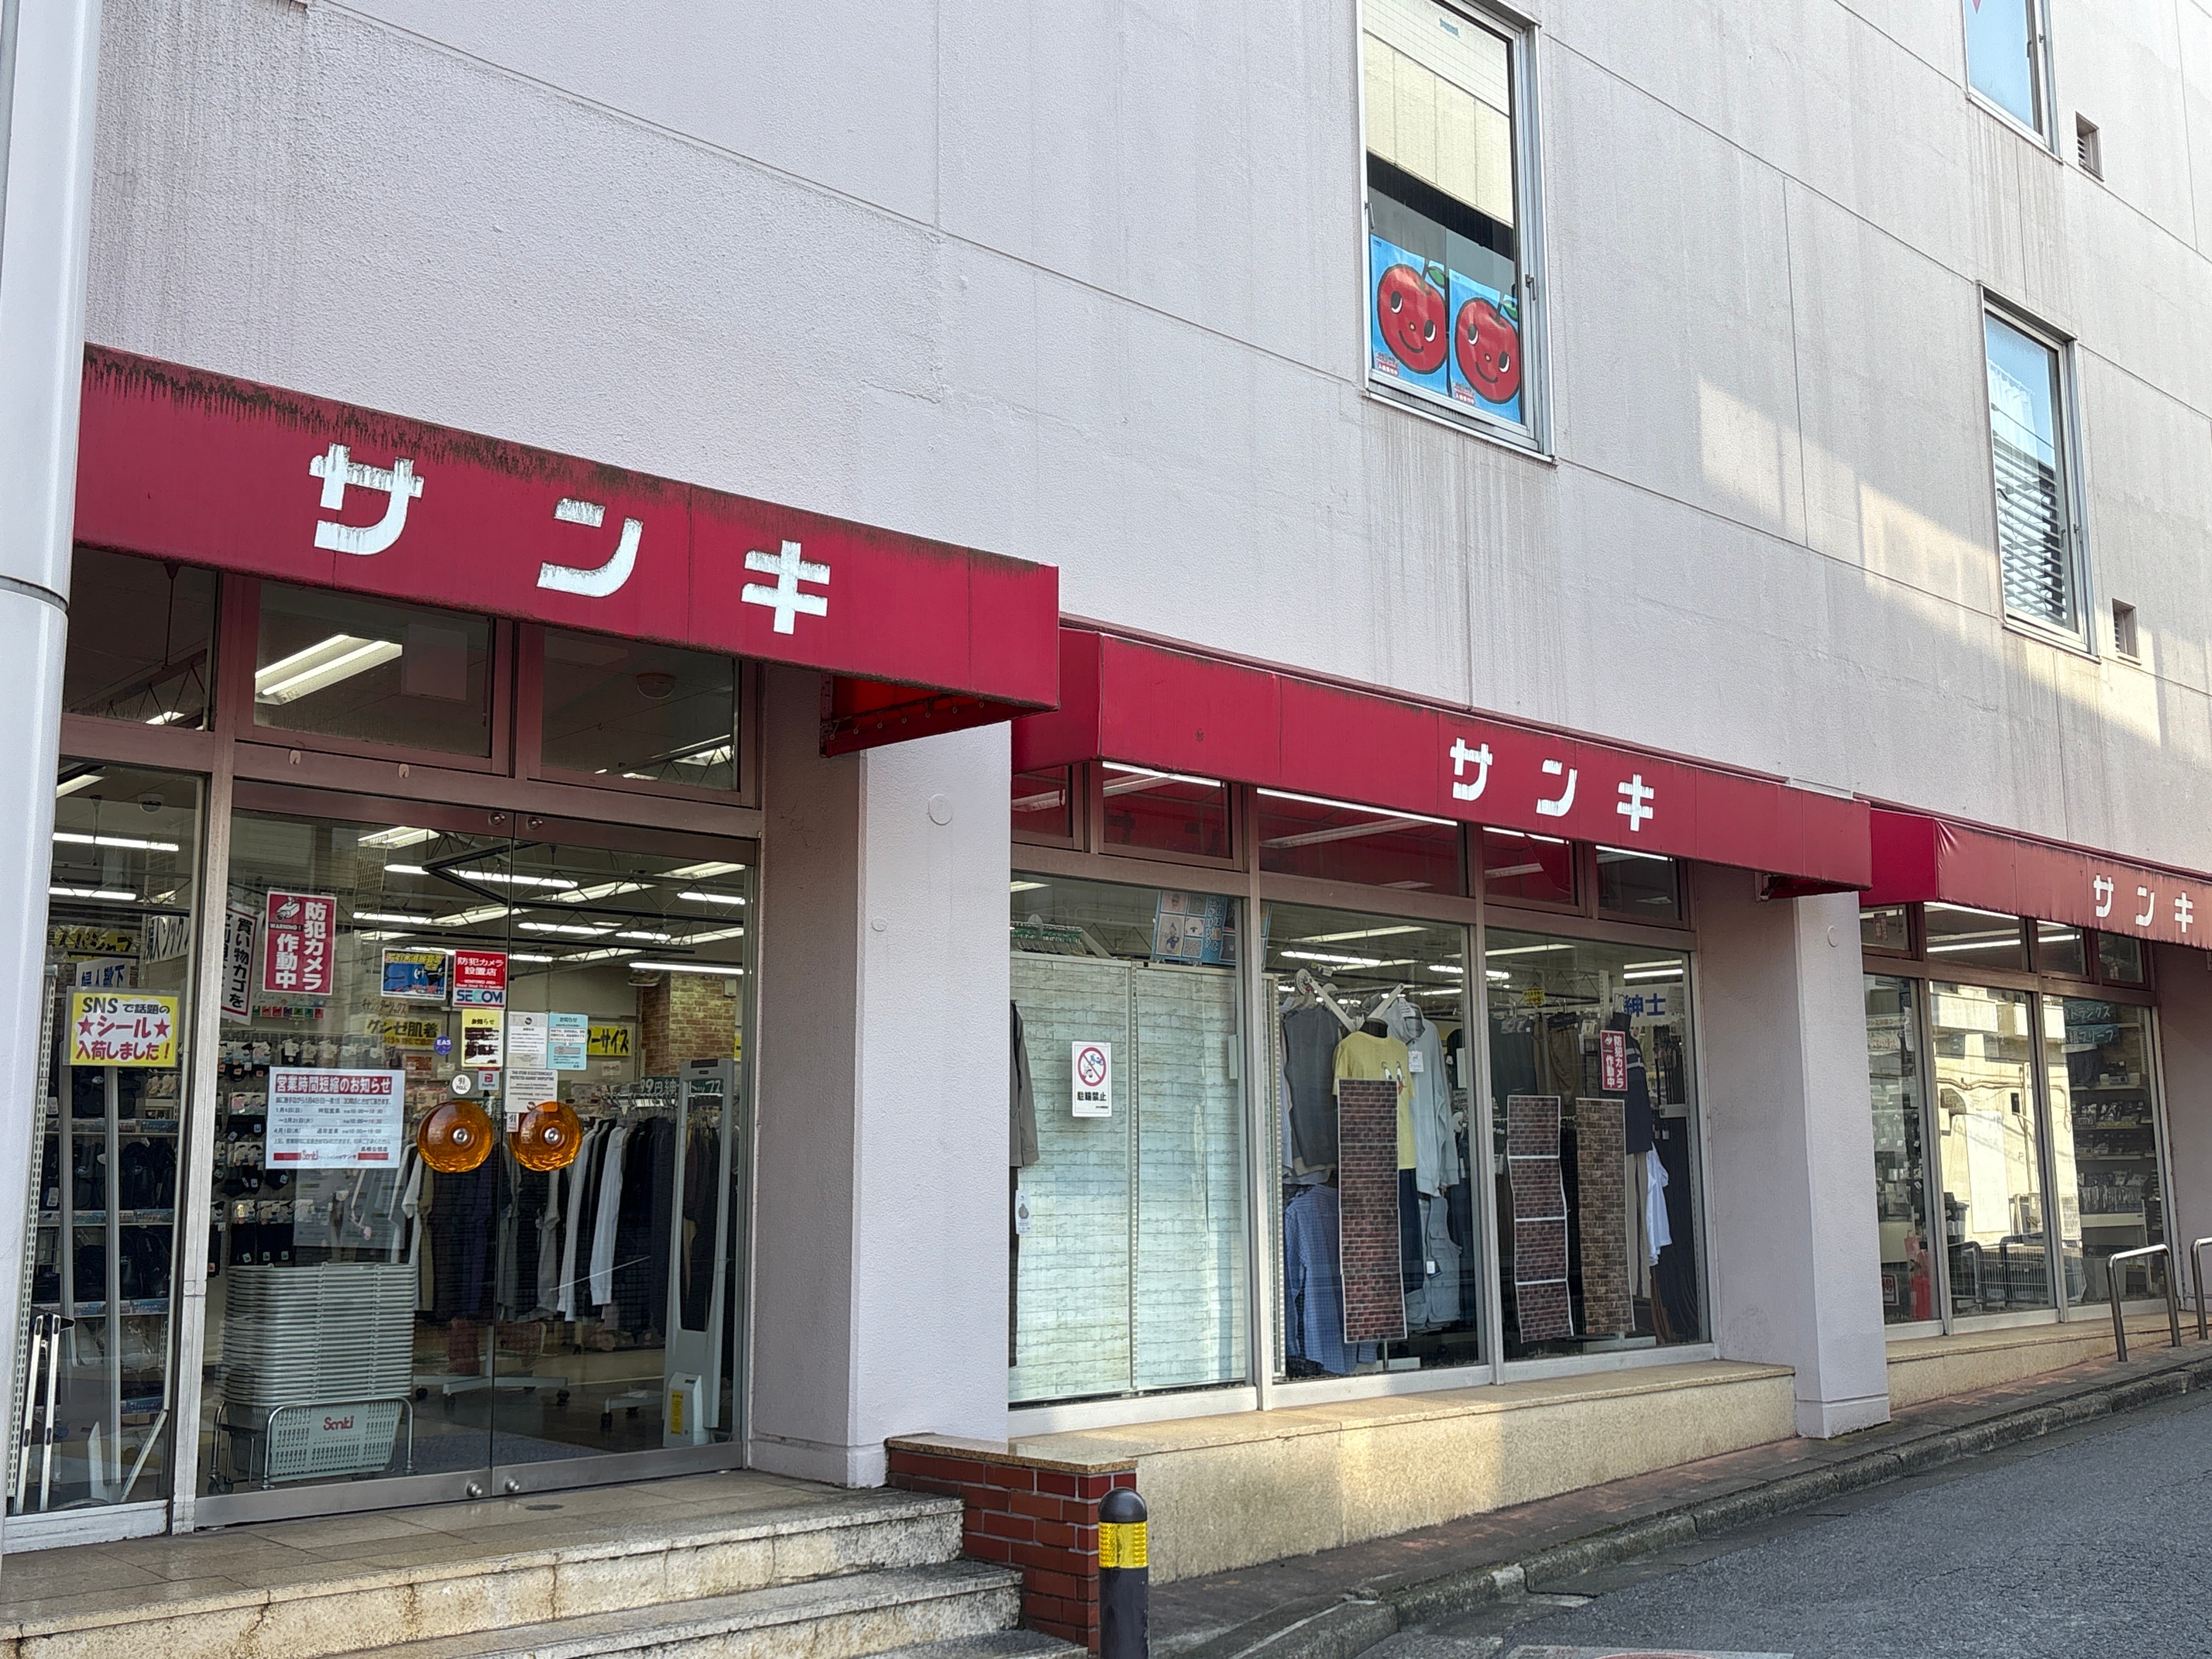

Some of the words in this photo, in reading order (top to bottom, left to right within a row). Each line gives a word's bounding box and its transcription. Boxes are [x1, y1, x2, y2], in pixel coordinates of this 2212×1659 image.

[308, 442, 832, 635] サンキ
[1450, 737, 1654, 832] サンキ
[2094, 874, 2193, 933] サンキ
[229, 917, 253, 1008] 買い物カゴを
[275, 933, 300, 989] 作動中
[302, 901, 328, 990] 防犯カメラ
[458, 957, 504, 968] 防犯カメラ
[465, 967, 496, 977] 設置店
[456, 989, 503, 1003] SECOM
[1623, 993, 1666, 1018] 紳士
[1605, 1054, 1615, 1088] 作動中
[1613, 1035, 1624, 1088] 防犯カメラ
[276, 1075, 391, 1093] 営業時間短縮のお知らせ
[1077, 1091, 1107, 1102] 駐輪禁止
